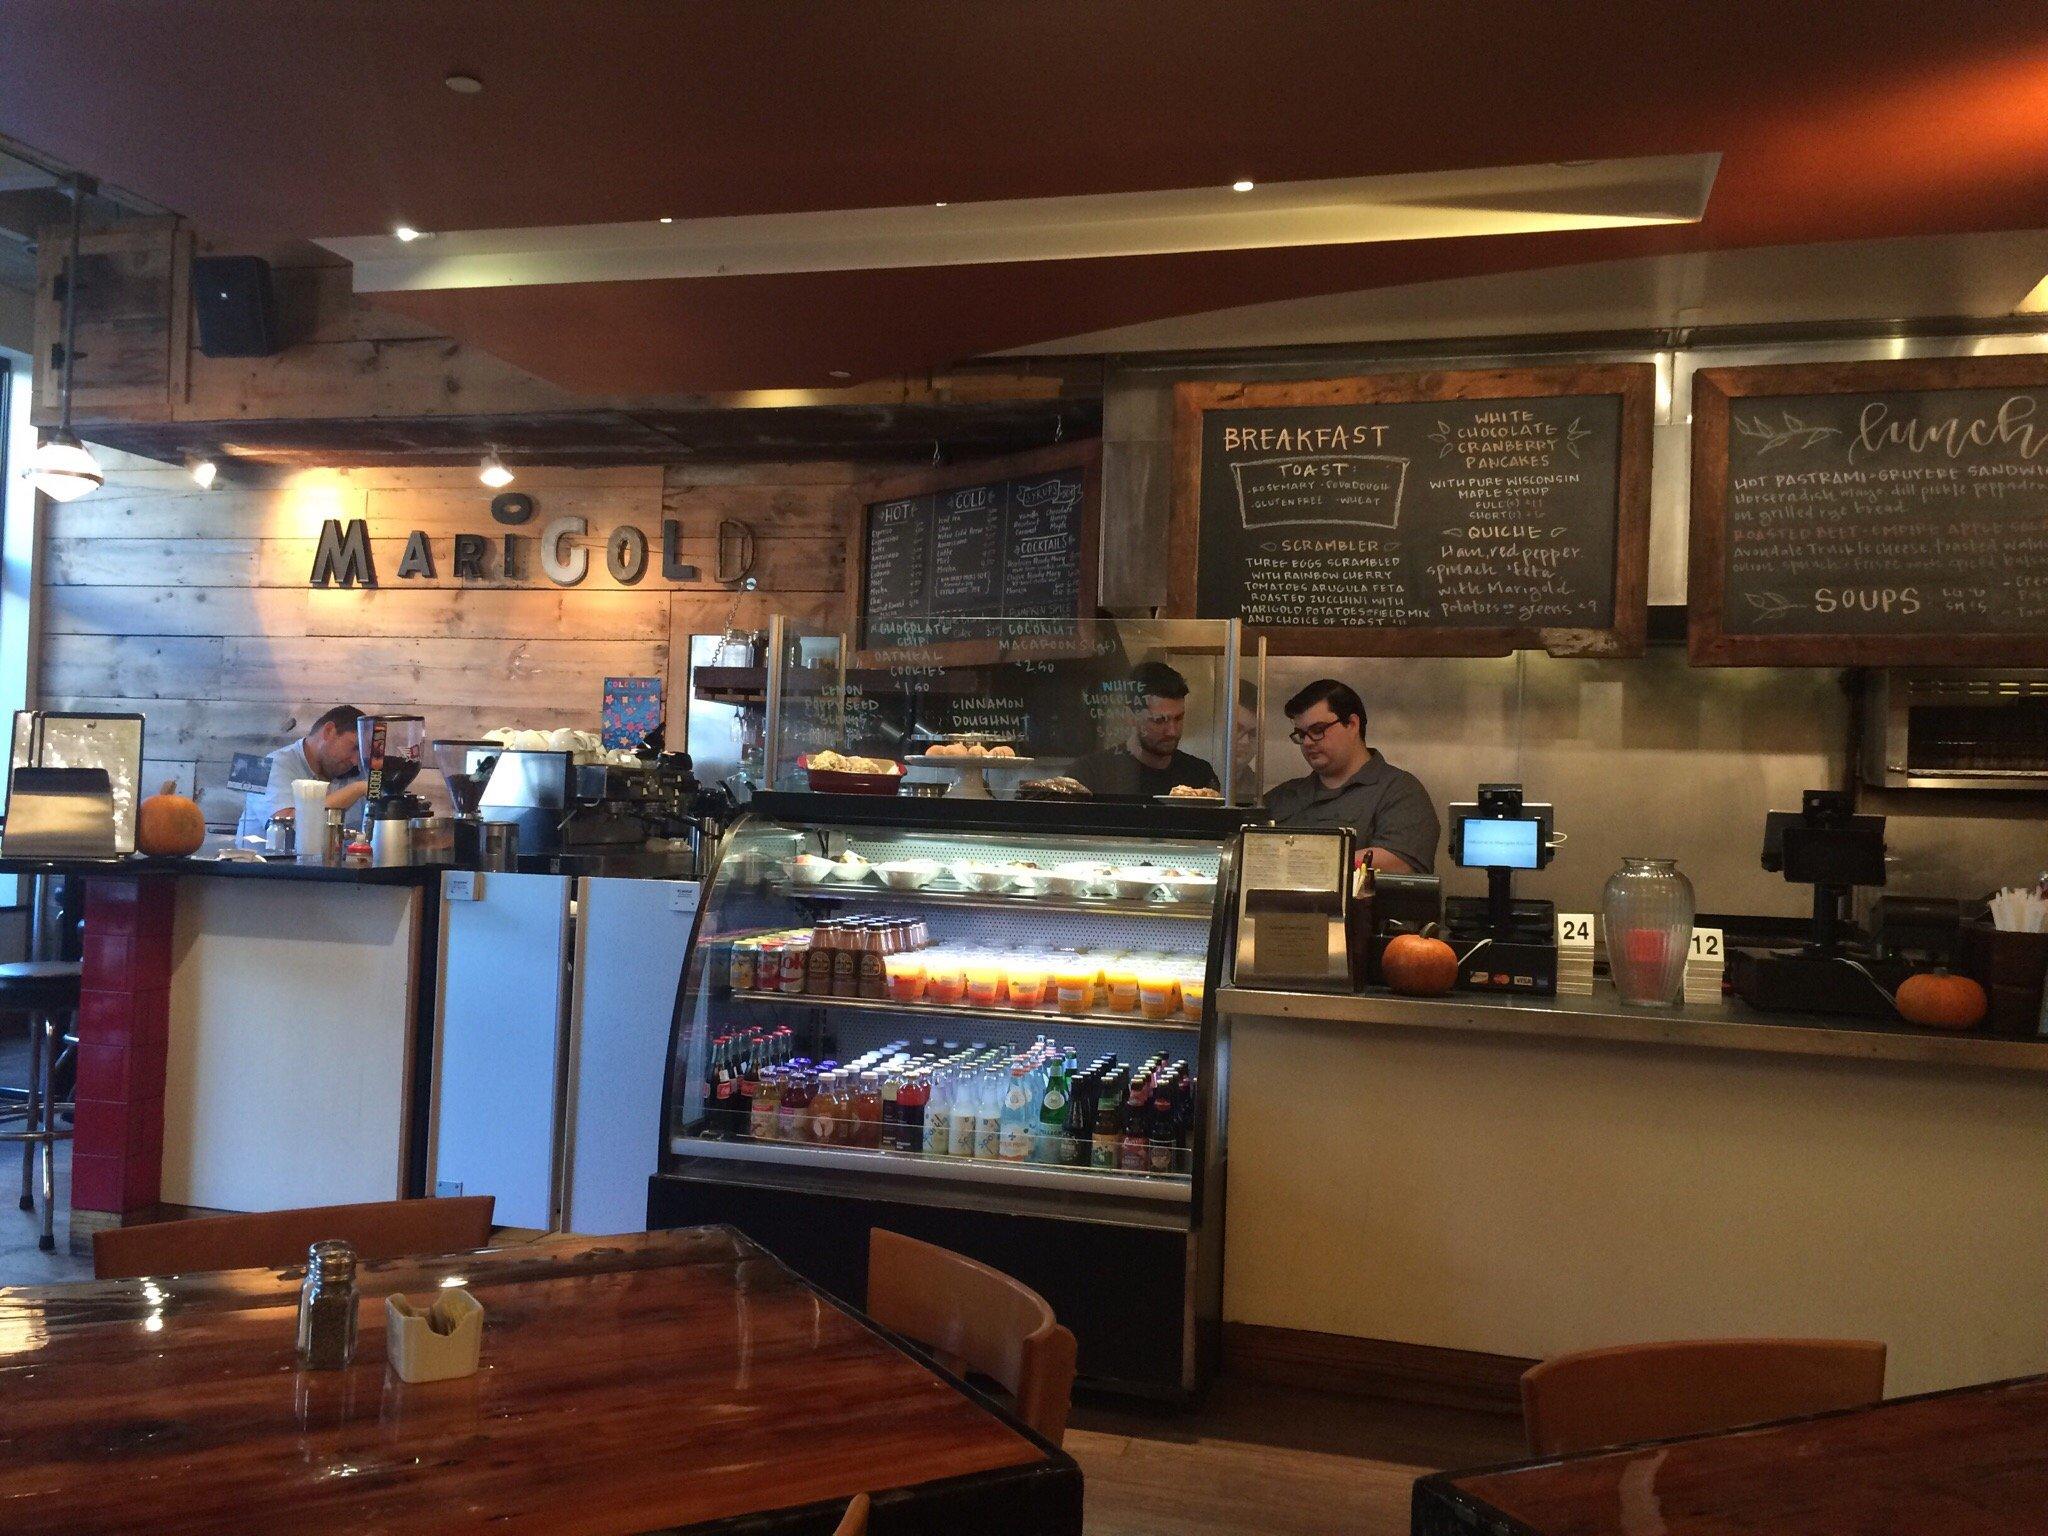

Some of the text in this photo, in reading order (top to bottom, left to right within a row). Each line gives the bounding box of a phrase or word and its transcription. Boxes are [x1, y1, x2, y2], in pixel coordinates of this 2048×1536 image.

[1474, 411, 1534, 424] WHITE
[1457, 422, 1558, 439] CHOCOLATE
[1848, 395, 2048, 465] lunch
[1223, 425, 1389, 451] BREAKFAST
[1457, 438, 1559, 454] CRANBERRY
[1465, 454, 1550, 470] PANCAKES
[1429, 474, 1580, 489] WITH PURE WISCONSIN
[1735, 476, 1767, 490] HOT
[955, 491, 986, 509] COLD
[1458, 487, 1550, 500] MAPLE SYRUP
[885, 504, 909, 522] HOT
[1468, 526, 1542, 539] QUICHE
[1020, 535, 1067, 554] COCKTAILS
[1281, 539, 1379, 553] SCRAMBLER
[1491, 543, 1520, 558] red
[1245, 557, 1400, 568] THREE EGGS SCRAMBLED
[1251, 570, 1393, 581] WITH RAINBOW CHERRY
[1426, 564, 1498, 584] spinach
[1244, 581, 1405, 593] TOMATOES ARUGULA FETA
[1438, 580, 1575, 602] with Marigold
[1251, 593, 1404, 606] ROASTED ZUCCHINI WITH
[1814, 587, 1920, 615] SOUPS
[1240, 604, 1302, 614] MARIGOLD
[1306, 606, 1366, 616] POTATOES
[1408, 609, 1430, 618] MIX
[1441, 600, 1500, 617] potatoes
[1518, 606, 1573, 621] greens
[1247, 615, 1273, 624] AND
[1276, 617, 1319, 625] CHOICE
[1323, 617, 1336, 625] OF
[1340, 617, 1385, 626] TOAST
[1008, 624, 1075, 636] COCONUT
[999, 639, 1089, 650] MACAROONS
[874, 650, 944, 662] OATMEAL
[890, 665, 946, 677] COOKIES
[1102, 680, 1147, 692] WHITE
[845, 699, 880, 711] SEED
[952, 697, 1024, 710] CINNAMON
[952, 713, 1031, 731] DOUGHNUT
[1563, 921, 1589, 940] 24
[1692, 934, 1718, 955] 12
